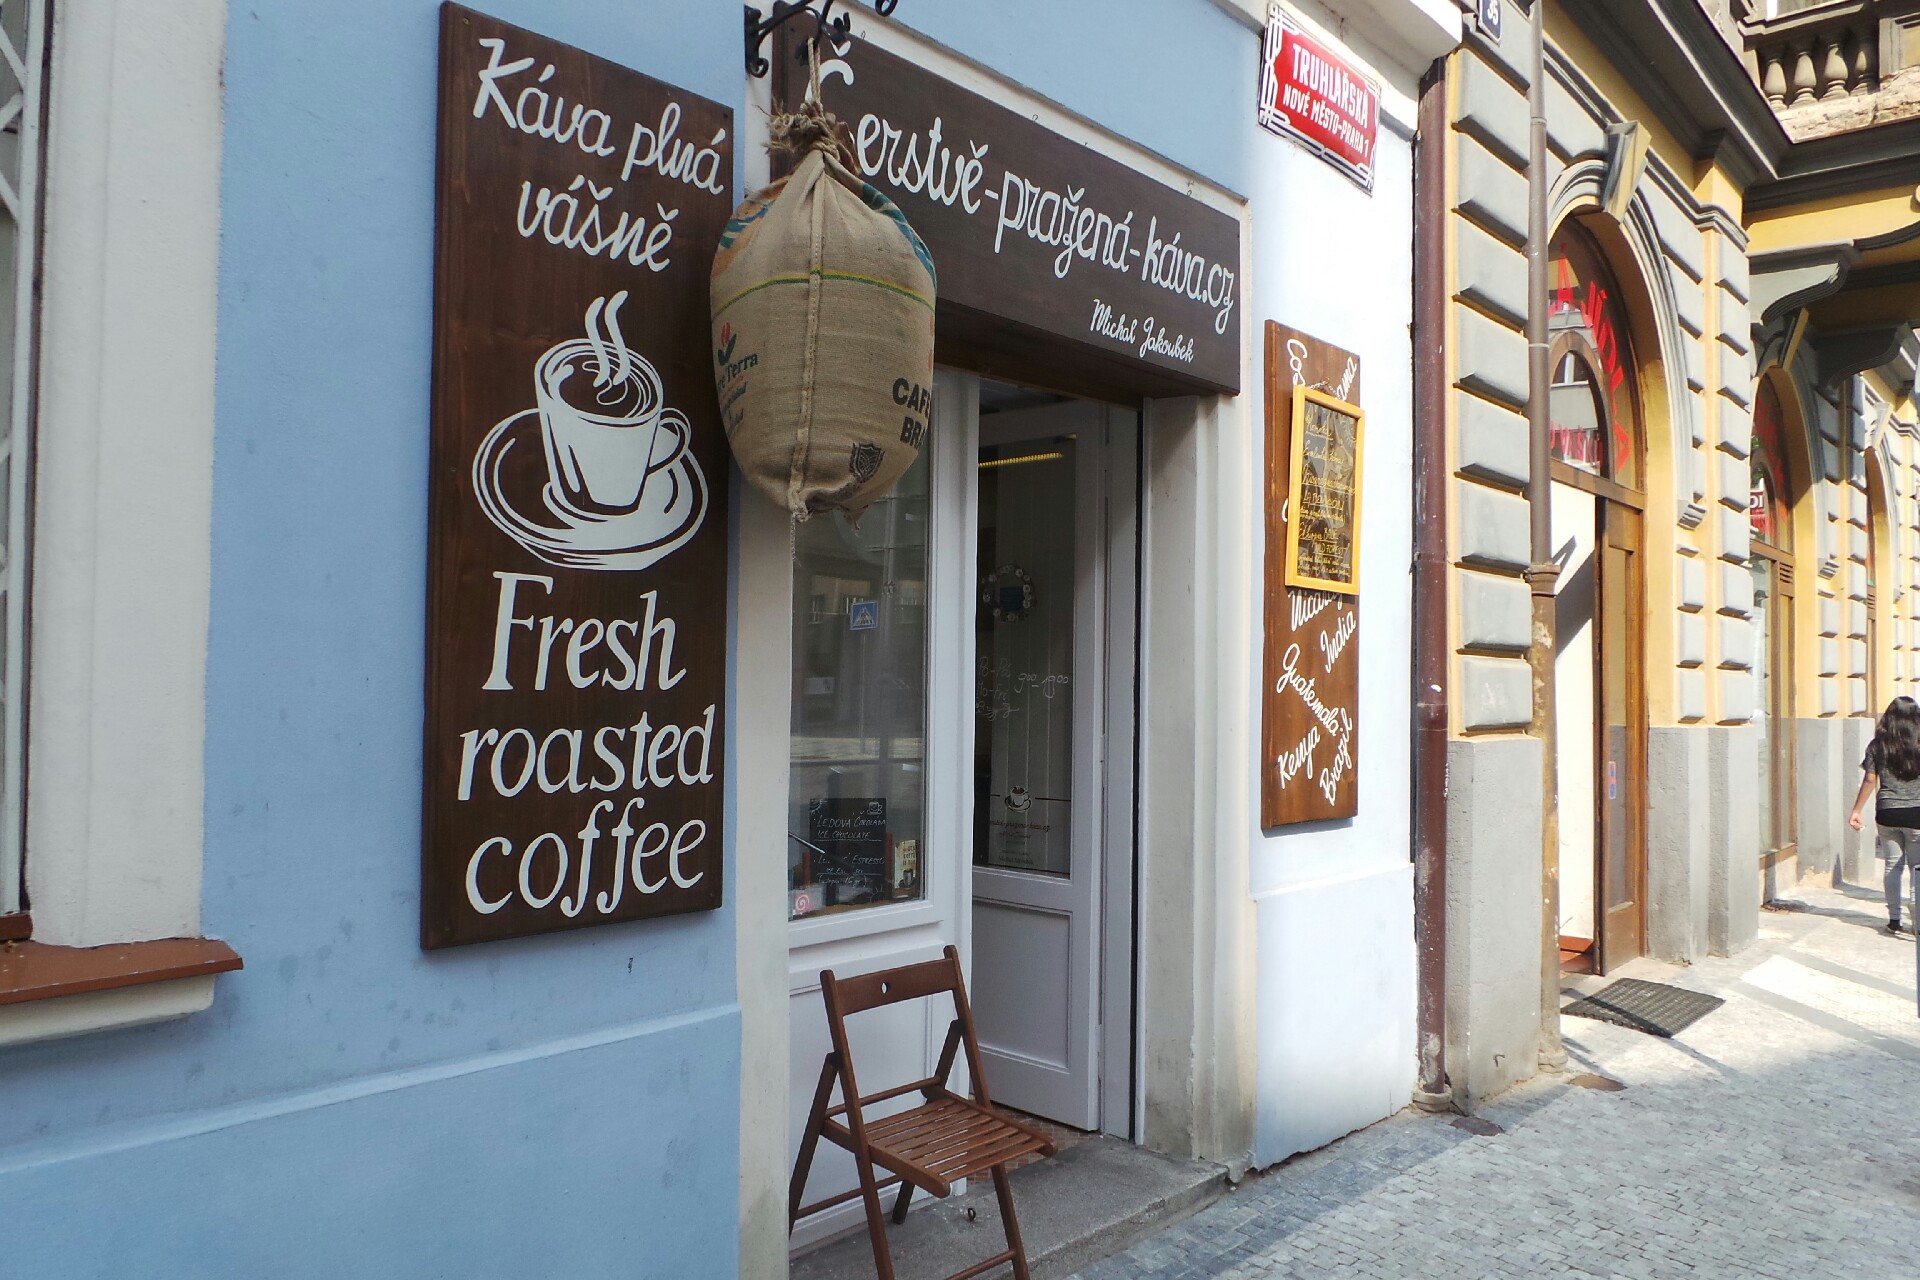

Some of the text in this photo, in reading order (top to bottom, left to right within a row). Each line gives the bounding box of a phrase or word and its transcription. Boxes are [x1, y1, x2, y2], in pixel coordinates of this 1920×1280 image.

[473, 37, 725, 195] Káva plná
[1282, 83, 1311, 118] NOVÉ
[1292, 42, 1369, 129] TRUHLÁŘSKÁ
[516, 174, 680, 273] vášně
[1090, 298, 1195, 364] Michal Jakoubek
[481, 570, 687, 691] Fresh
[1320, 610, 1357, 674] India
[1276, 642, 1339, 738] Guatemala
[457, 703, 717, 801] roasted
[1277, 724, 1321, 790] Kenya
[1319, 707, 1353, 807] Brazil
[465, 796, 707, 918] coffee
